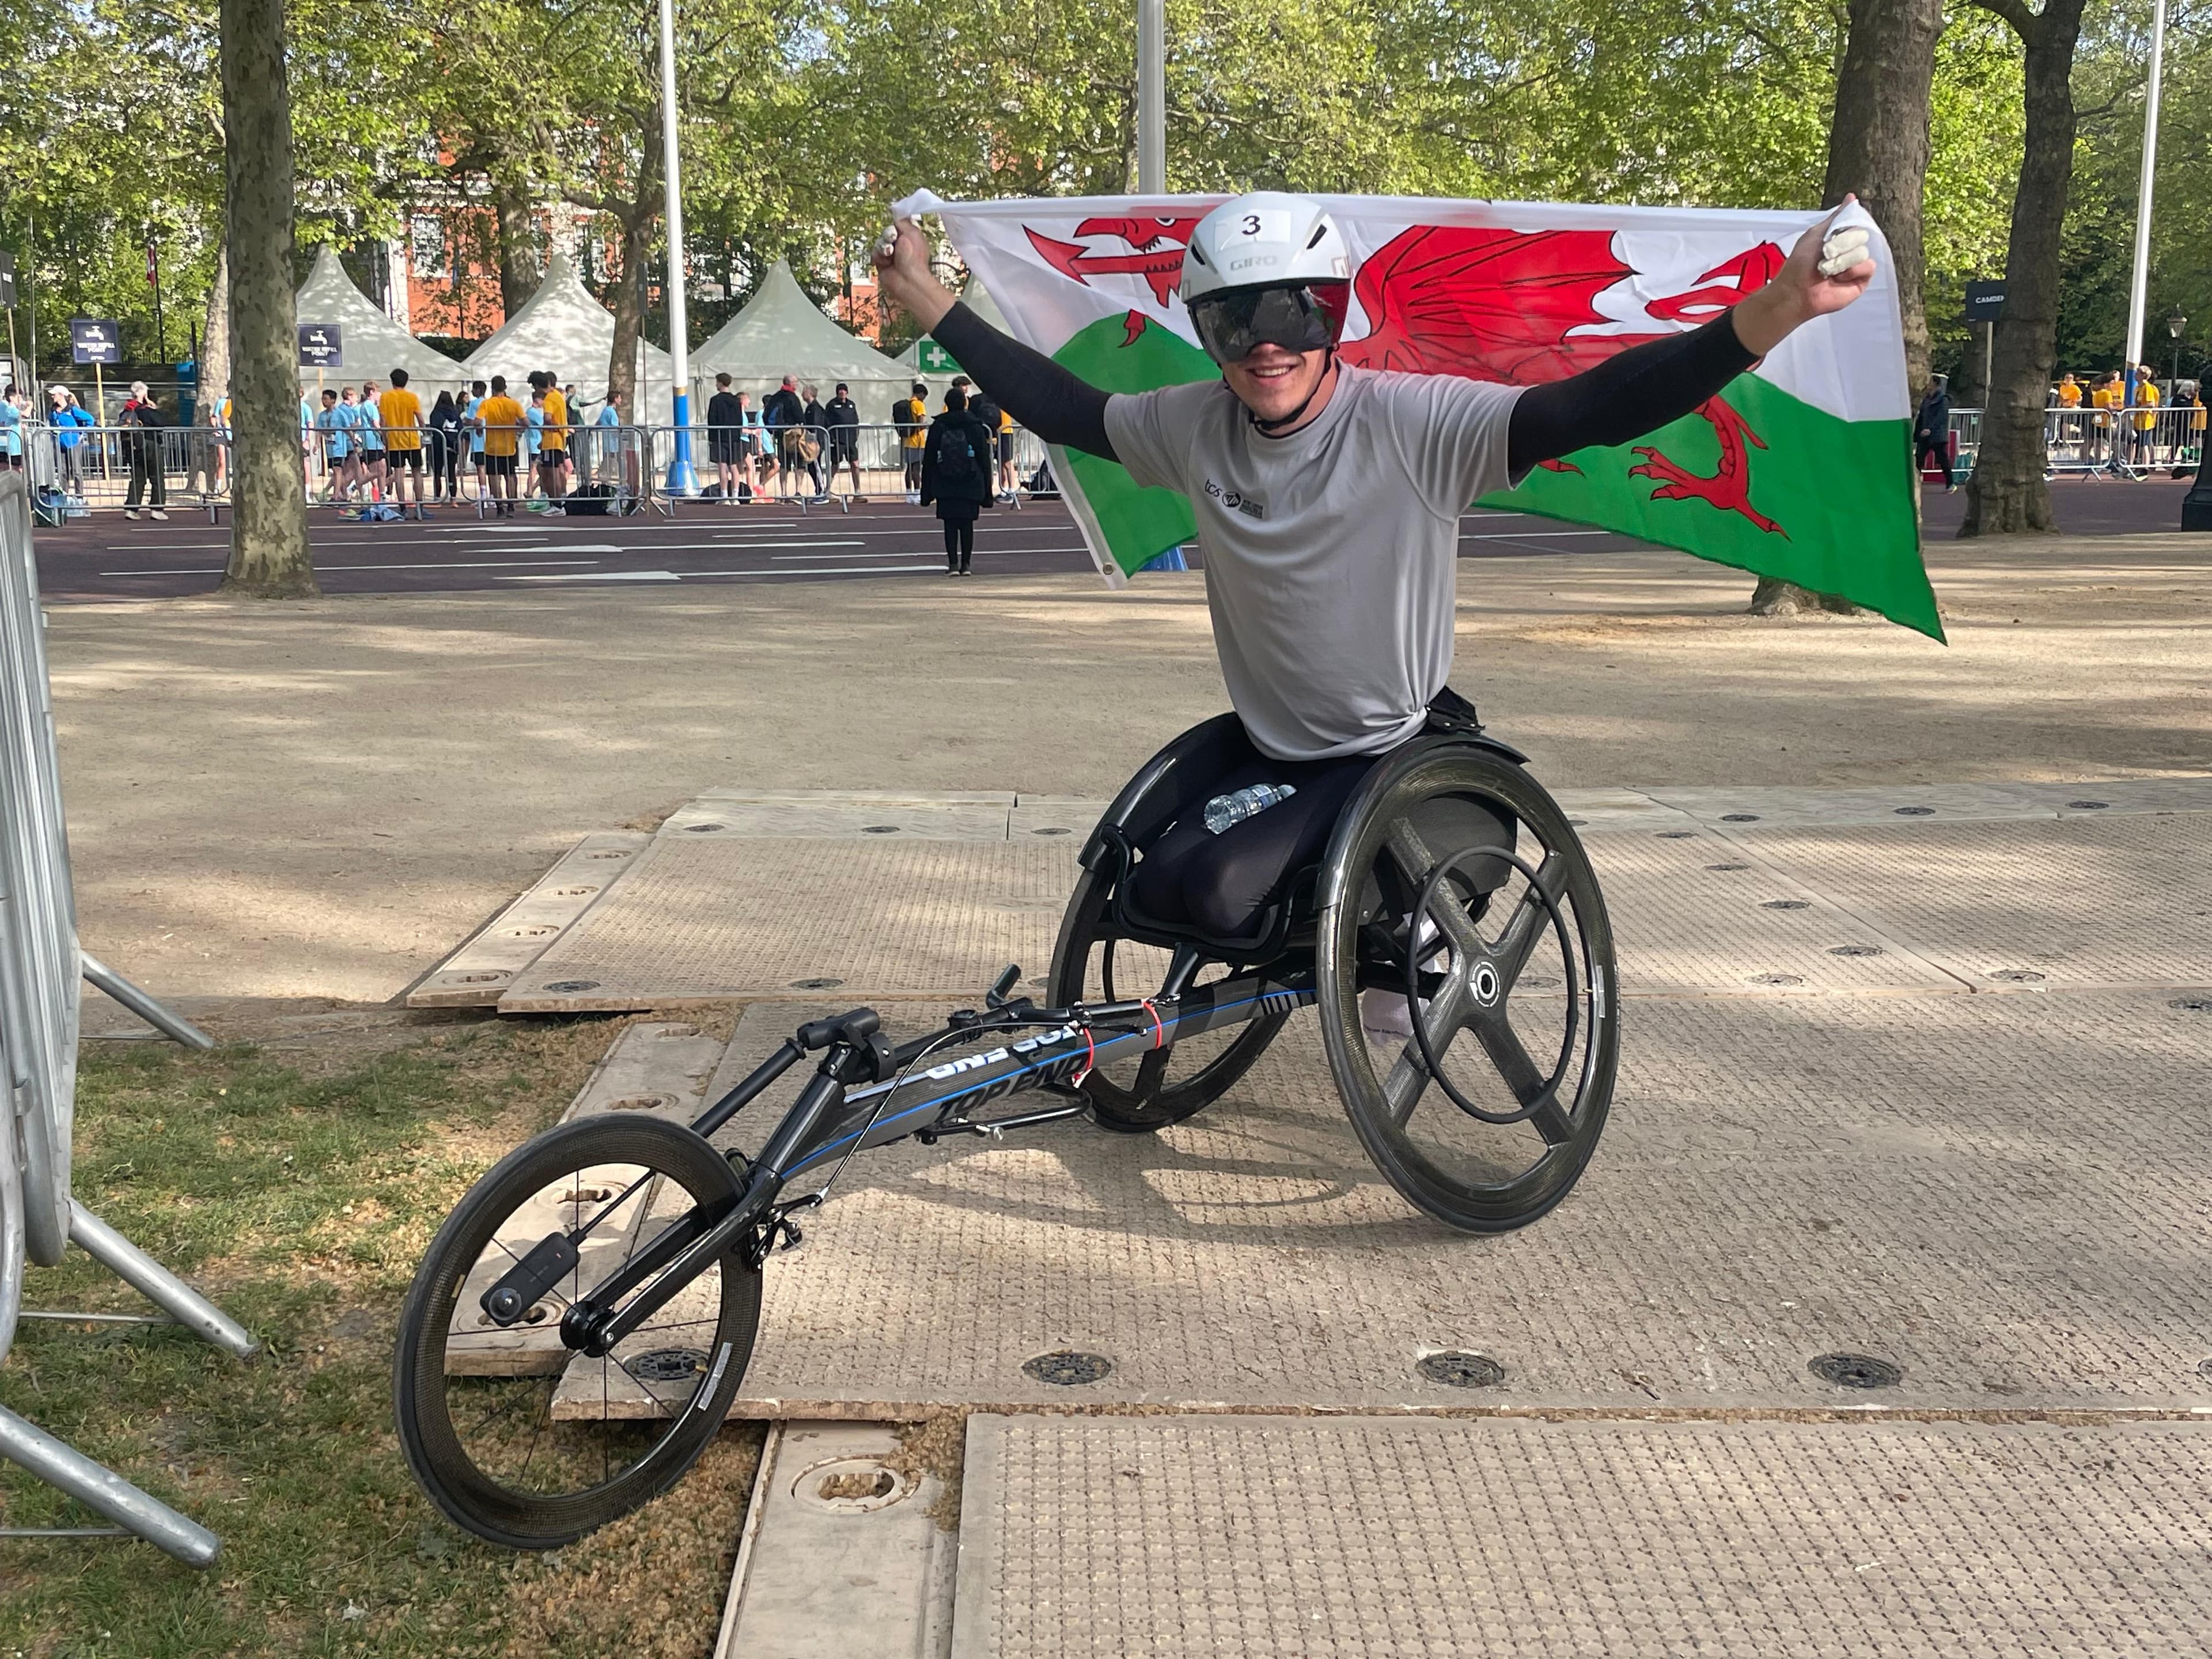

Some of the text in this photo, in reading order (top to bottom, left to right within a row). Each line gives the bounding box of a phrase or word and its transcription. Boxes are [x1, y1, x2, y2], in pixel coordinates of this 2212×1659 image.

[1241, 215, 1262, 236] 3
[1230, 255, 1278, 271] GIRO
[935, 1081, 1009, 1122] TOP
